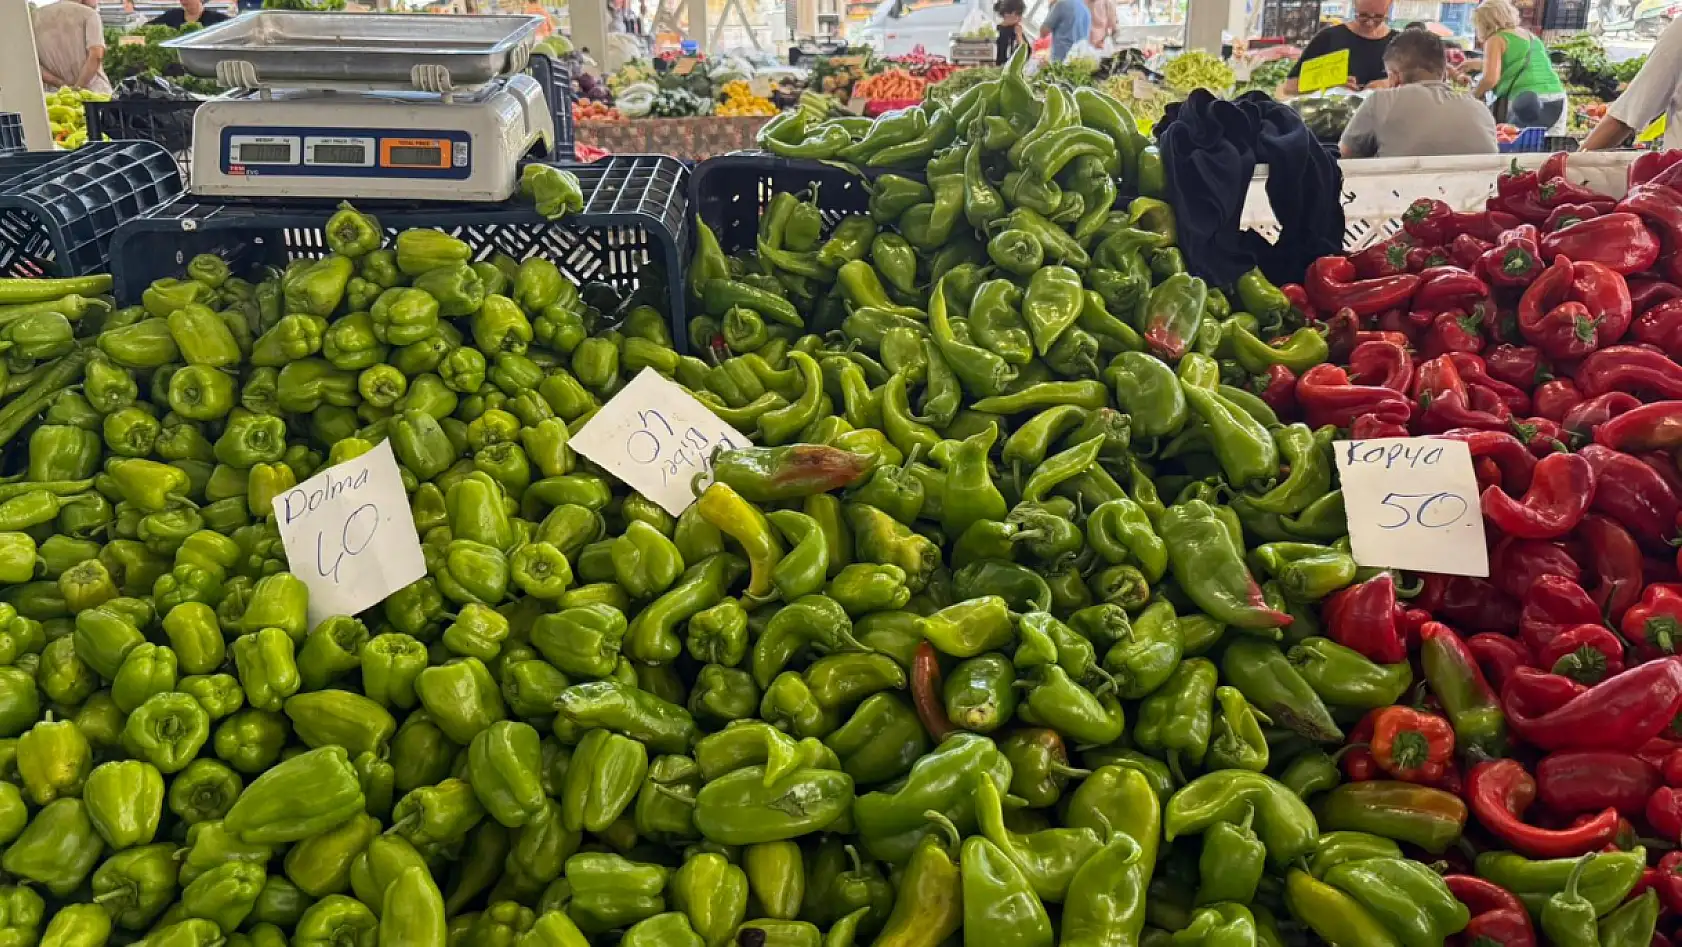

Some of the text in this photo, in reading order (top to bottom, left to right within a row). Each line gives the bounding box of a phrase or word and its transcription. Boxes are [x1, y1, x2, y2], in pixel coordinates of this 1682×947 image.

[627, 409, 674, 464] 40
[662, 427, 710, 488] Biber
[285, 468, 369, 525] Dolma
[317, 503, 380, 583] 40
